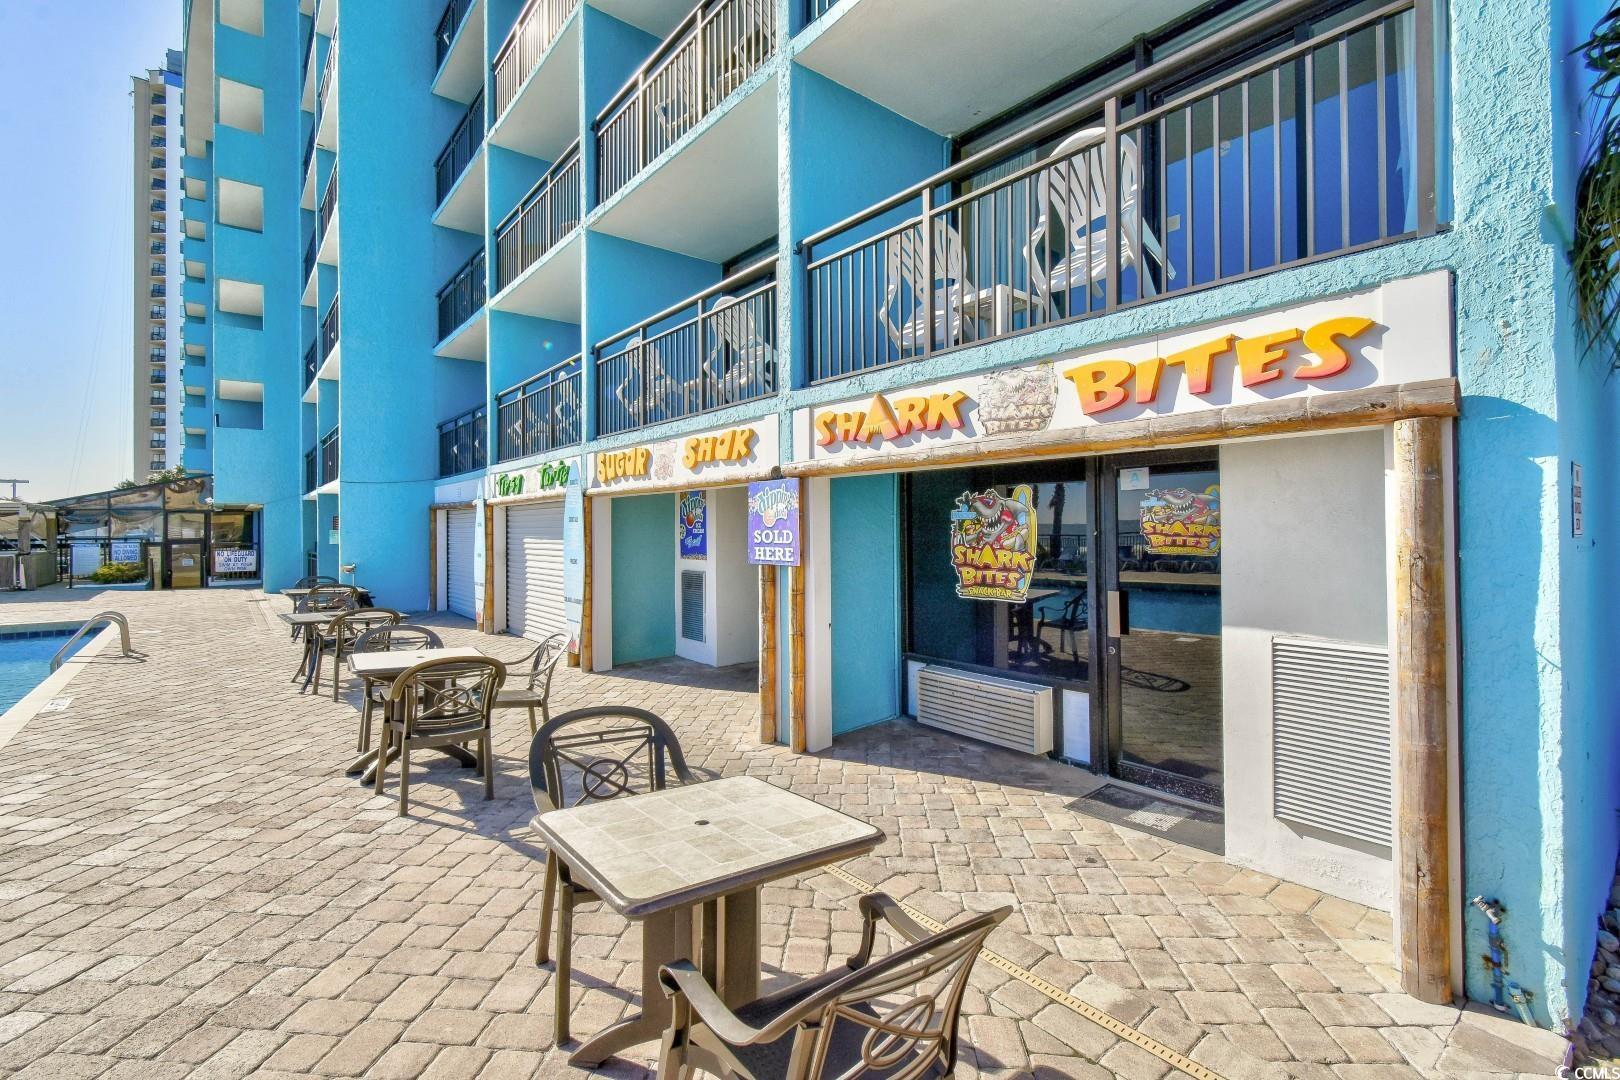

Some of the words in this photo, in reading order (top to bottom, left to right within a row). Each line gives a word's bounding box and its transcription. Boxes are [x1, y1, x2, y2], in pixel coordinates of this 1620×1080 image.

[815, 392, 968, 446] SHARK
[1062, 316, 1376, 416] BITES
[597, 447, 651, 485] SUGAR
[682, 426, 756, 470] SHAK
[754, 529, 793, 544] SOLD
[1149, 534, 1210, 549] BITES
[754, 546, 794, 562] HERE
[954, 544, 1032, 570] SHARK
[960, 567, 1021, 588] BITES
